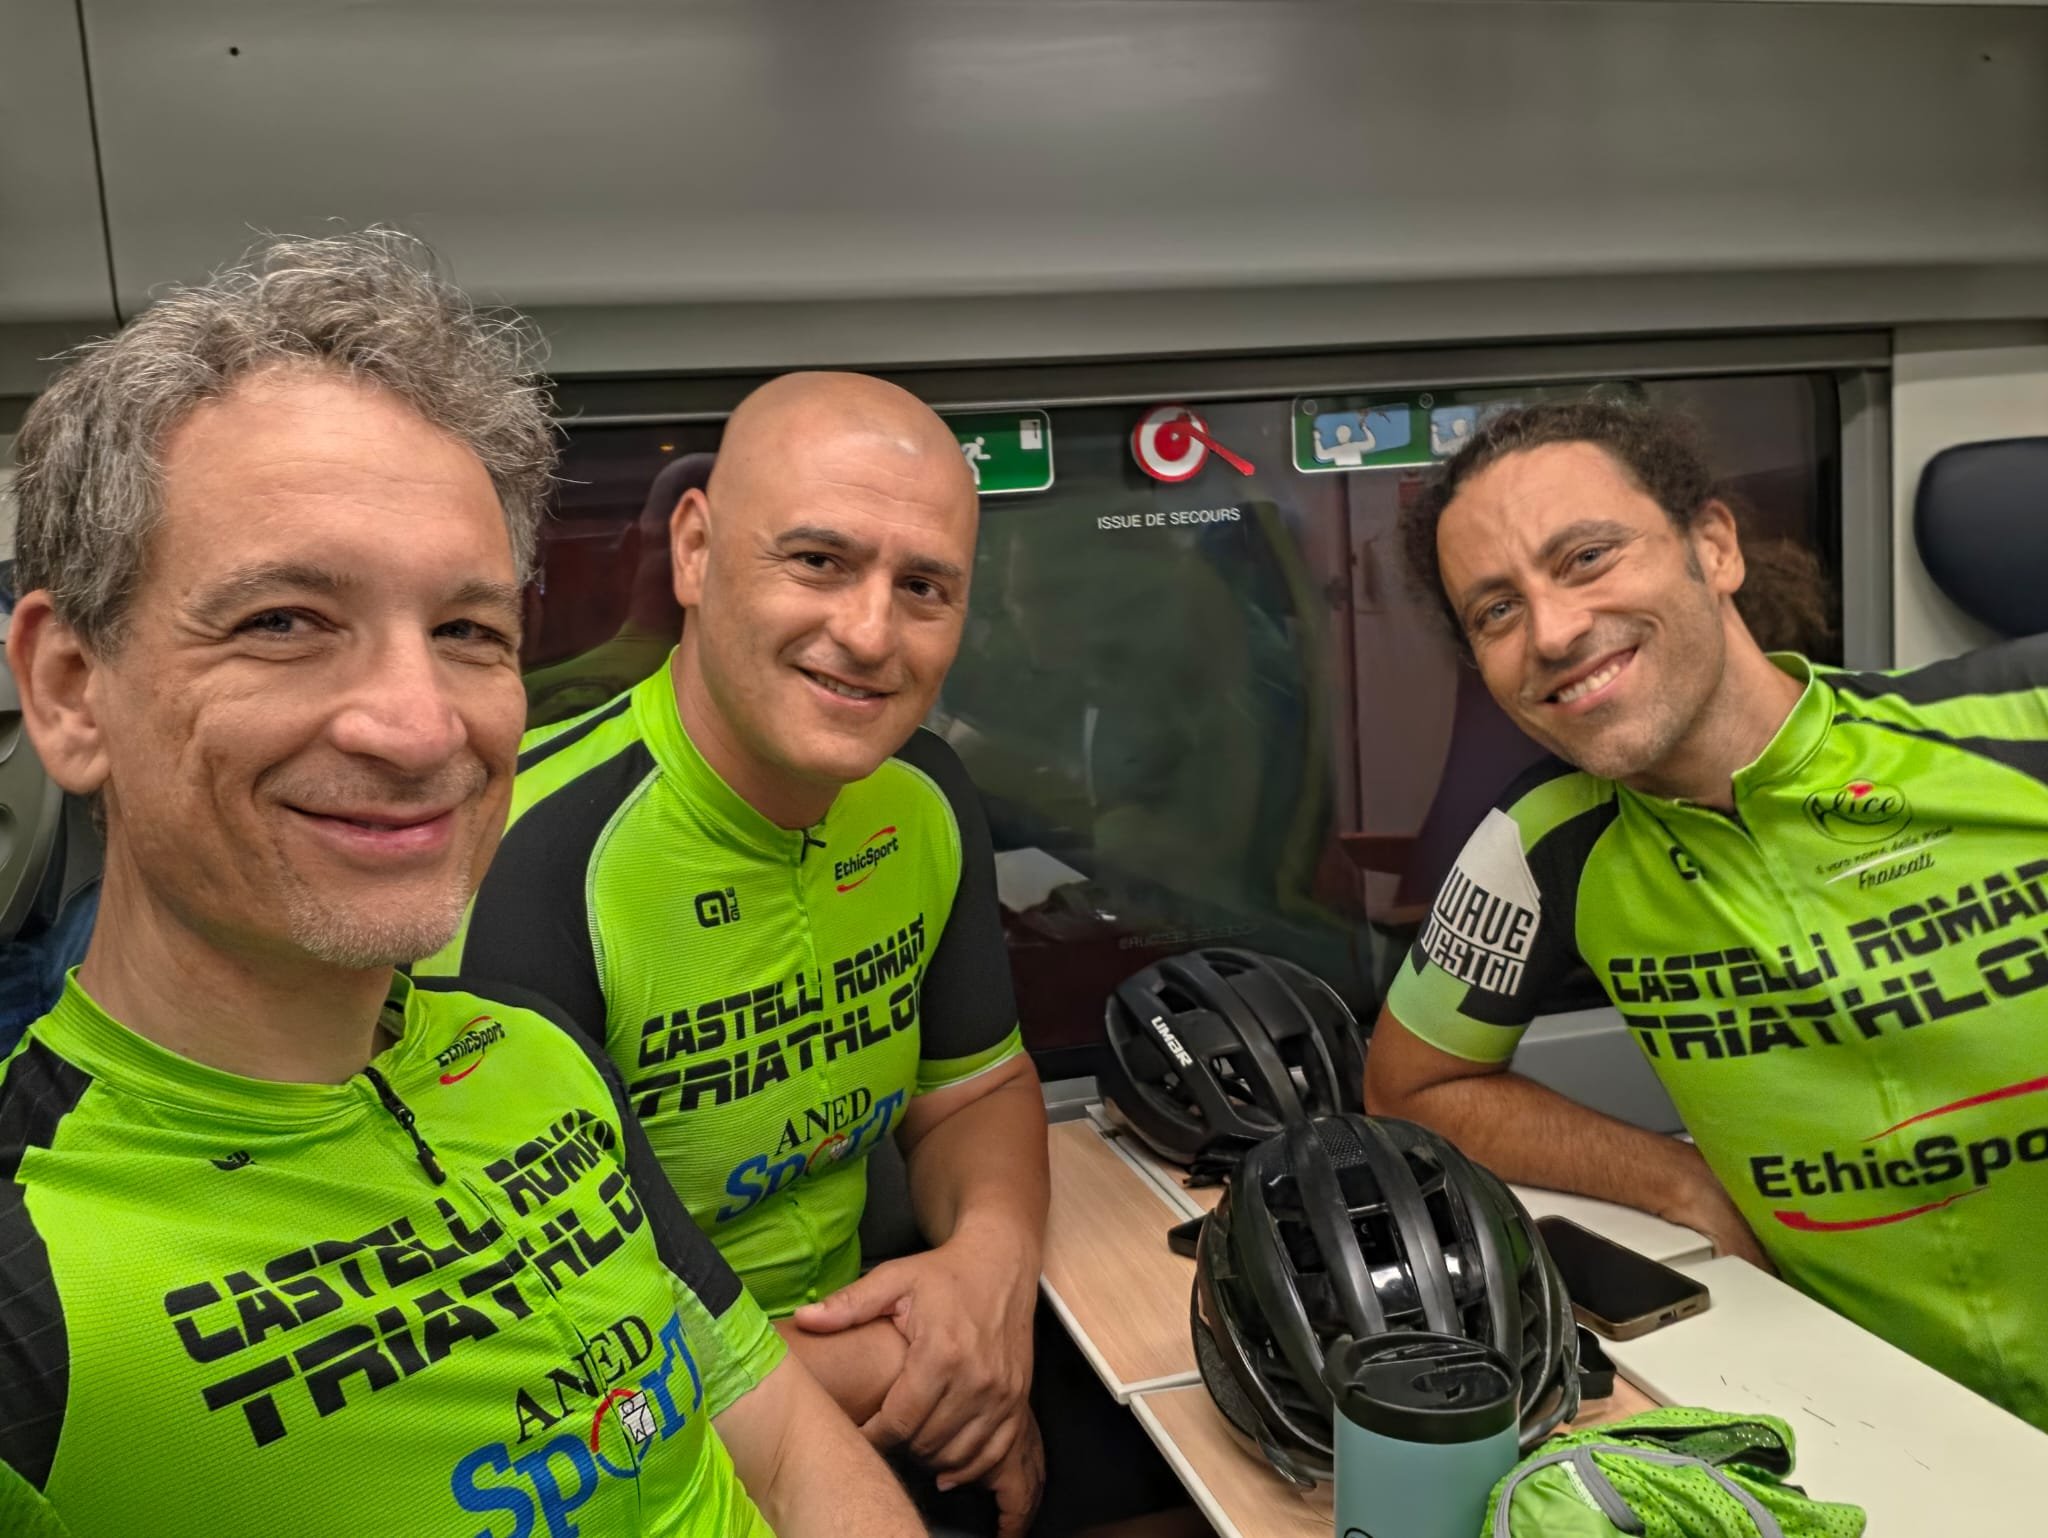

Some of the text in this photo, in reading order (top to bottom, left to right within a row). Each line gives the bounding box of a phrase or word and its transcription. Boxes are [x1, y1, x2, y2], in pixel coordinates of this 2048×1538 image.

[1097, 507, 1241, 529] ISSUE DE SECOURS
[835, 837, 899, 881] EthicSport
[1437, 866, 1535, 955] WAVE
[1608, 932, 1839, 1003] CASTELLI
[435, 1021, 506, 1067] EthicSport
[774, 1087, 871, 1156] ANED
[515, 1315, 653, 1444] ANED
